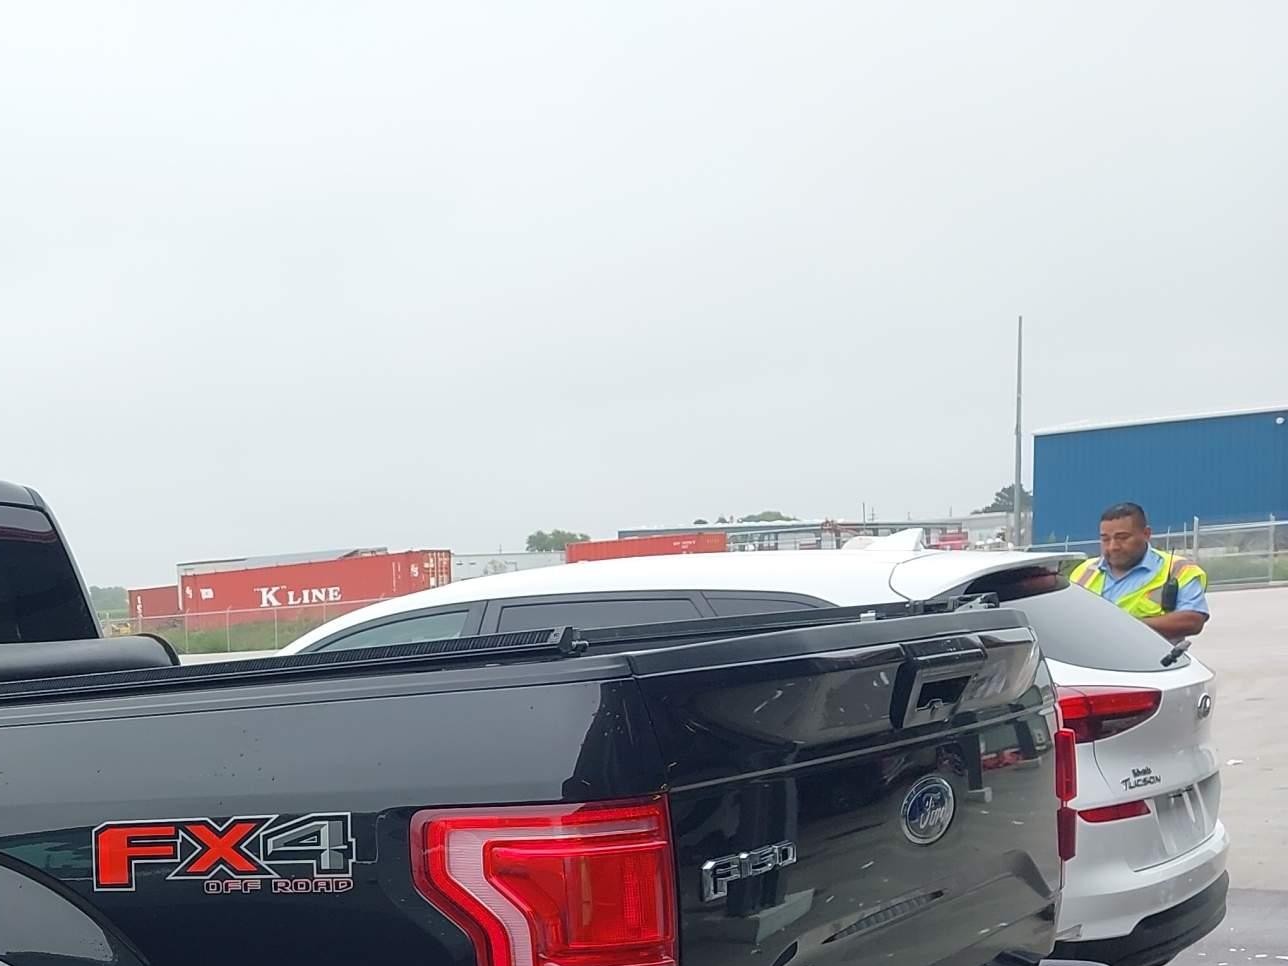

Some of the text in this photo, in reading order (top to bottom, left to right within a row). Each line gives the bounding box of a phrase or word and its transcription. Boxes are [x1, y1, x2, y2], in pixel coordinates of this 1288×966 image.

[287, 586, 342, 605] LINE
[92, 812, 356, 892] FX4
[203, 878, 354, 894] OFF ROAD
